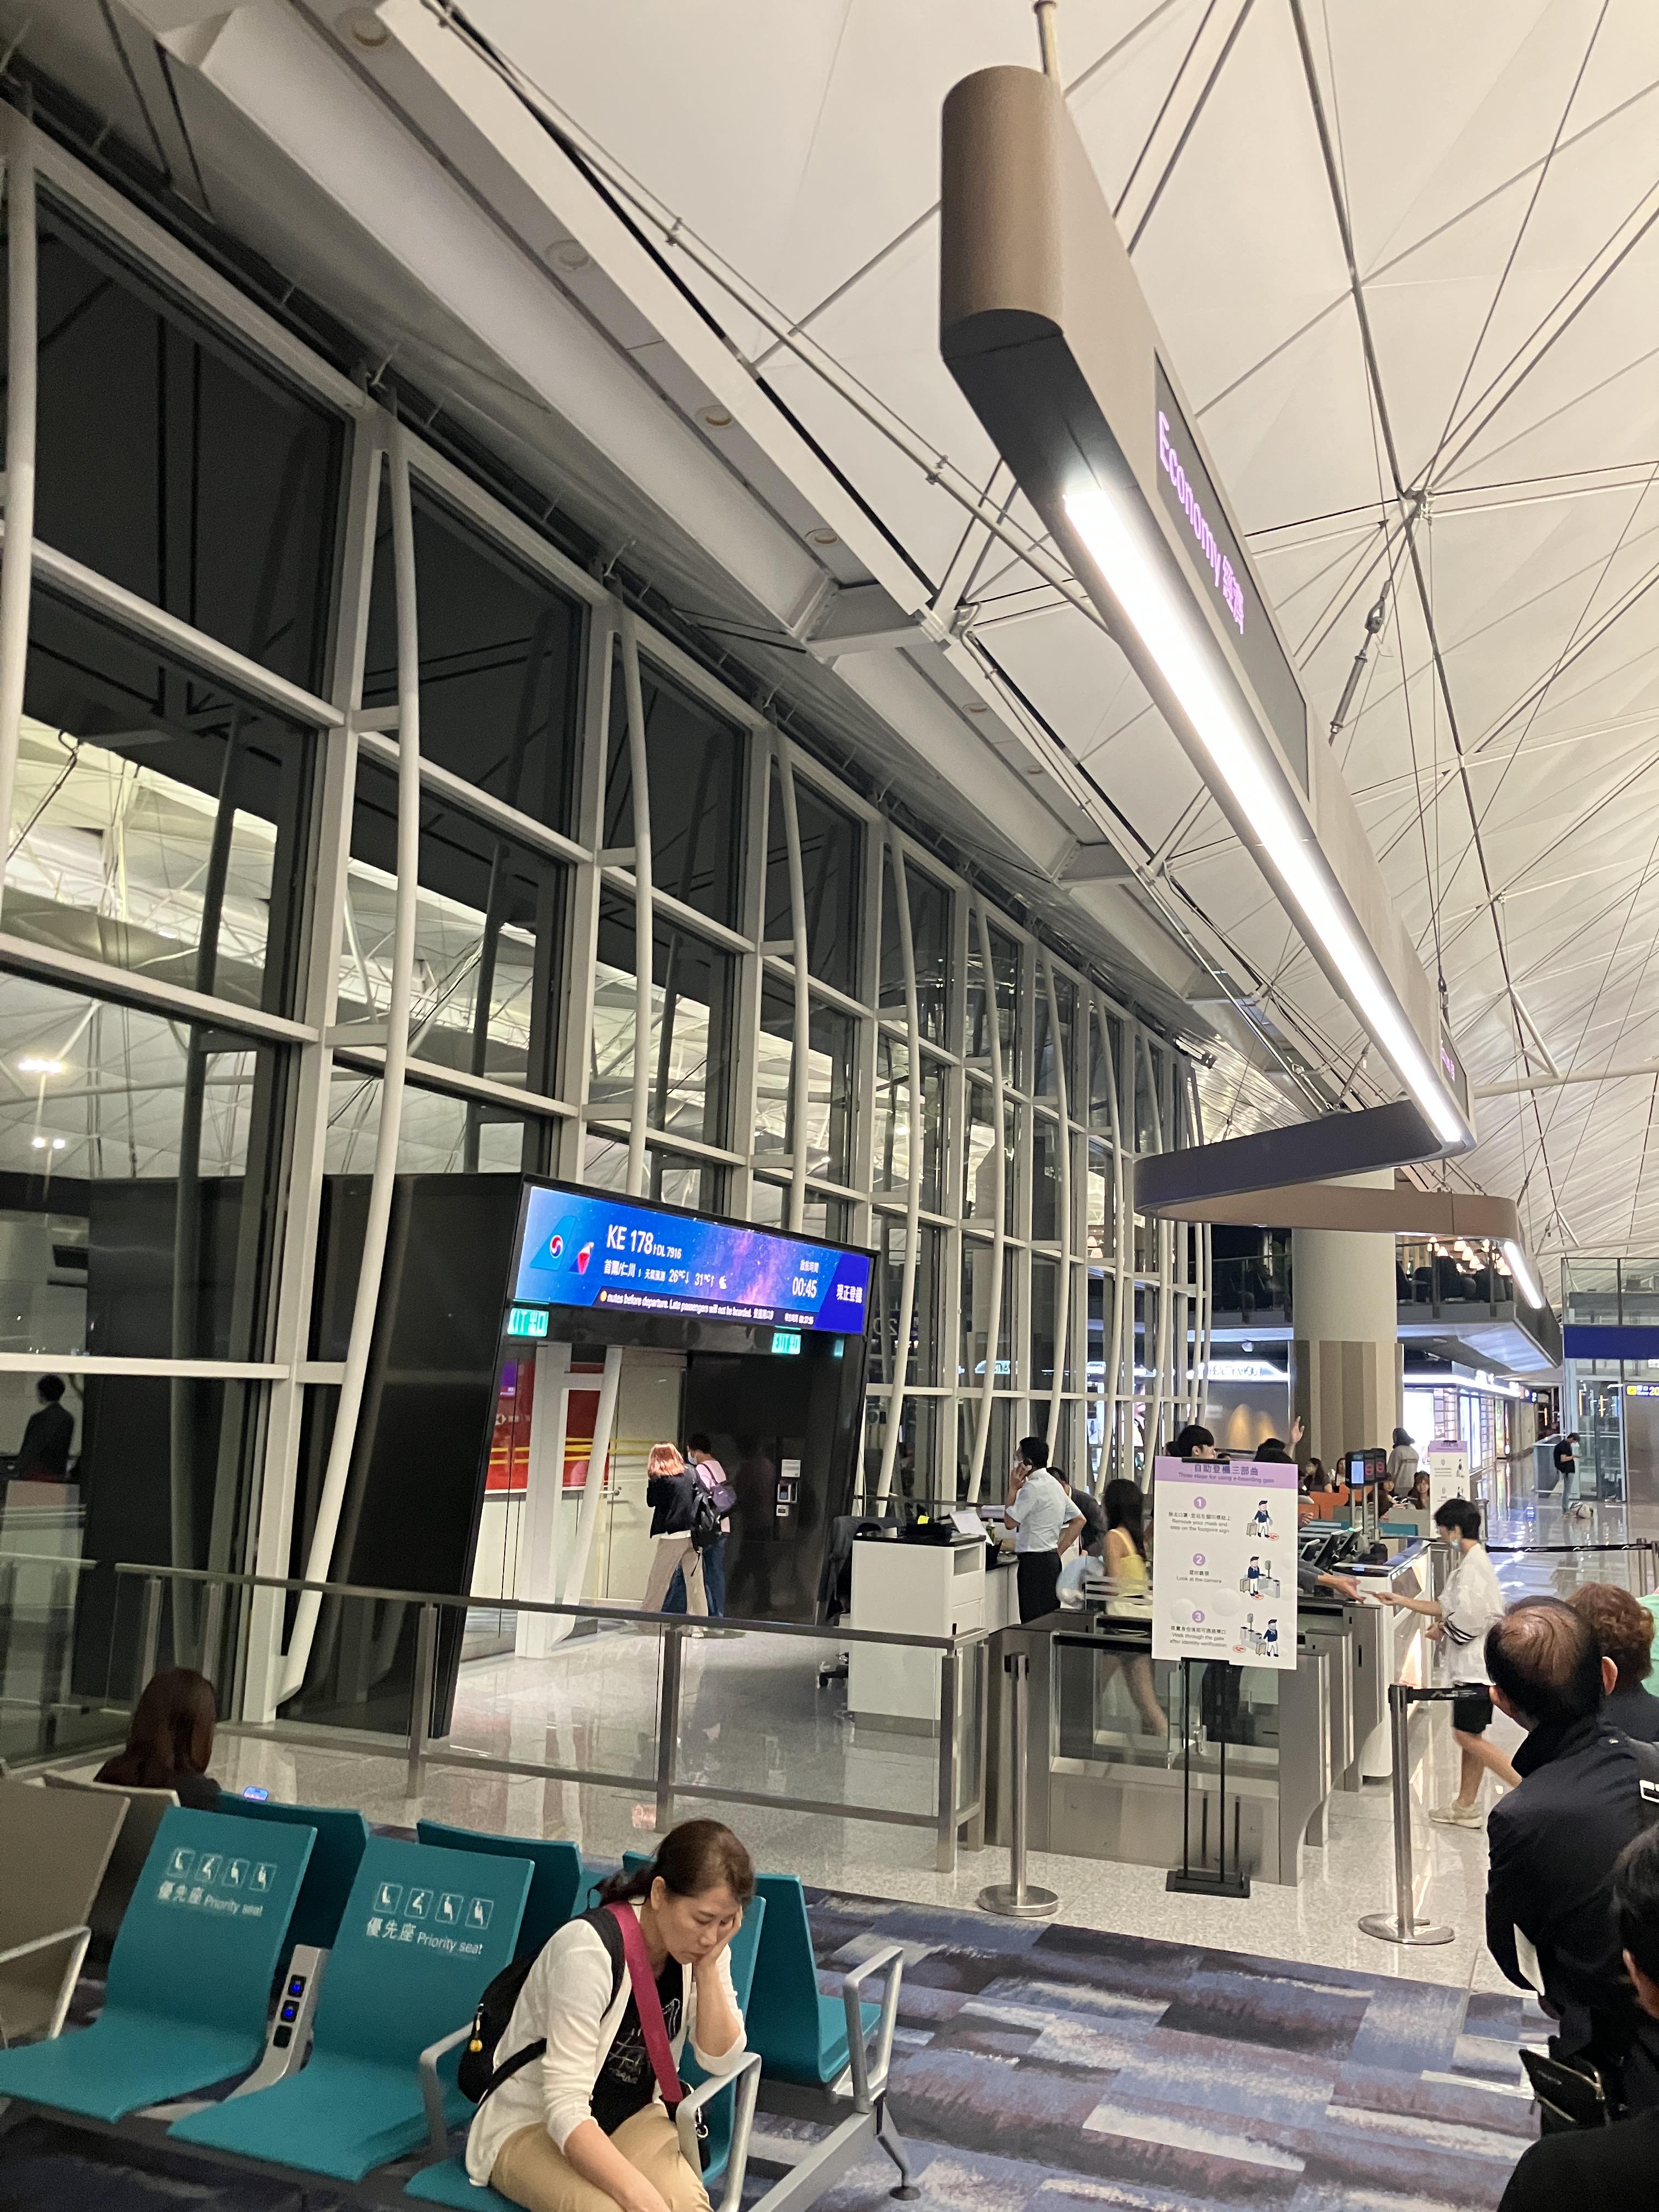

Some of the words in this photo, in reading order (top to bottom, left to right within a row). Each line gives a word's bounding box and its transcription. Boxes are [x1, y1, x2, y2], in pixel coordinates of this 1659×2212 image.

[1159, 411, 1221, 587] Economy
[607, 1224, 627, 1250] KE
[630, 1230, 654, 1255] 178
[658, 1247, 665, 1257] DL
[667, 1246, 682, 1259] 7916
[792, 1277, 817, 1299] 00:45
[836, 1284, 863, 1304] 現正登機
[624, 1293, 642, 1306] before
[669, 1299, 681, 1310] Late
[680, 1302, 709, 1314] passengers
[709, 1304, 718, 1314] will
[718, 1306, 726, 1314] not
[726, 1305, 732, 1316] be
[529, 1311, 548, 1335] 出口
[1195, 1464, 1258, 1475] 自助登機三部曲
[1197, 1498, 1201, 1507] 1
[1196, 1555, 1202, 1564] 2
[1194, 1612, 1201, 1621] 3
[204, 1894, 241, 1915] Priority
[242, 1904, 263, 1917] seat
[366, 1917, 416, 1942] 優先座
[417, 1931, 457, 1954] Priority
[459, 1942, 483, 1955] seat
